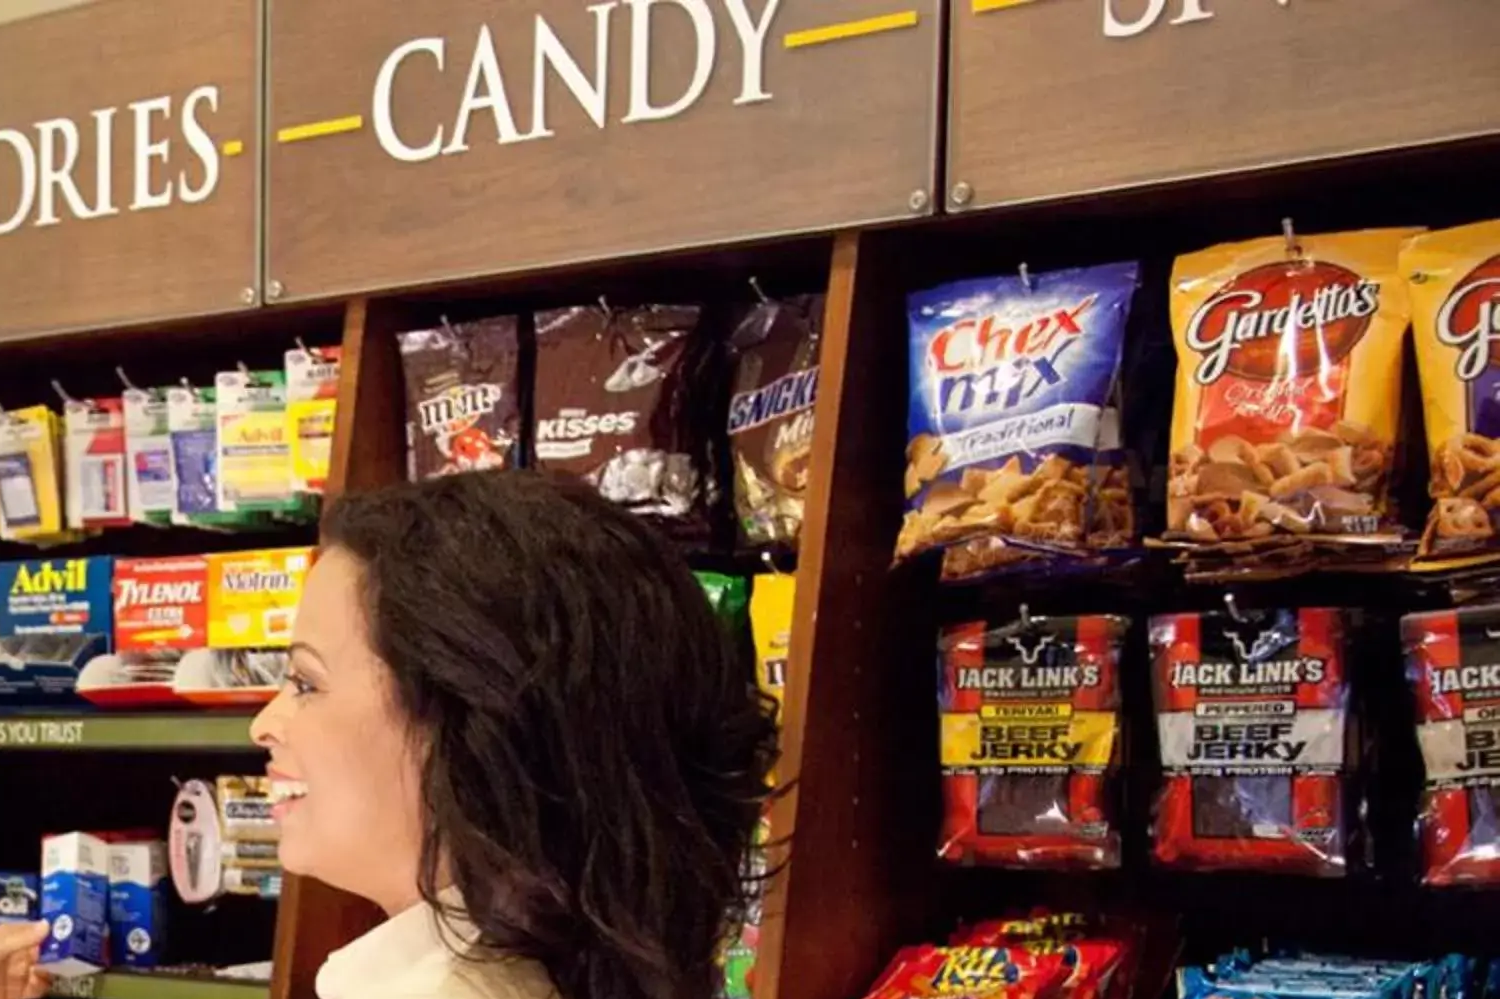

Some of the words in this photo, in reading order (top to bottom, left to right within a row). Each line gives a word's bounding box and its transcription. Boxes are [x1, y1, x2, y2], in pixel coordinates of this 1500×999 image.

[372, 0, 780, 162] CANDY
[931, 294, 1099, 373] Chex
[1187, 278, 1380, 384] Gardetto's
[957, 407, 1076, 449] Traditional
[10, 557, 90, 594] Advil
[118, 578, 203, 612] TYLENOL
[958, 665, 1014, 689] JACK
[1020, 663, 1099, 688] LINK'S
[1171, 662, 1232, 687] JACK
[1240, 656, 1325, 684] LINK'S
[6, 722, 39, 743] YOU
[41, 722, 84, 743] TRUST
[980, 725, 1071, 742] BEEF
[1195, 723, 1294, 741] BEEF
[970, 741, 1084, 760] JERKY
[1186, 742, 1308, 761] JERKY
